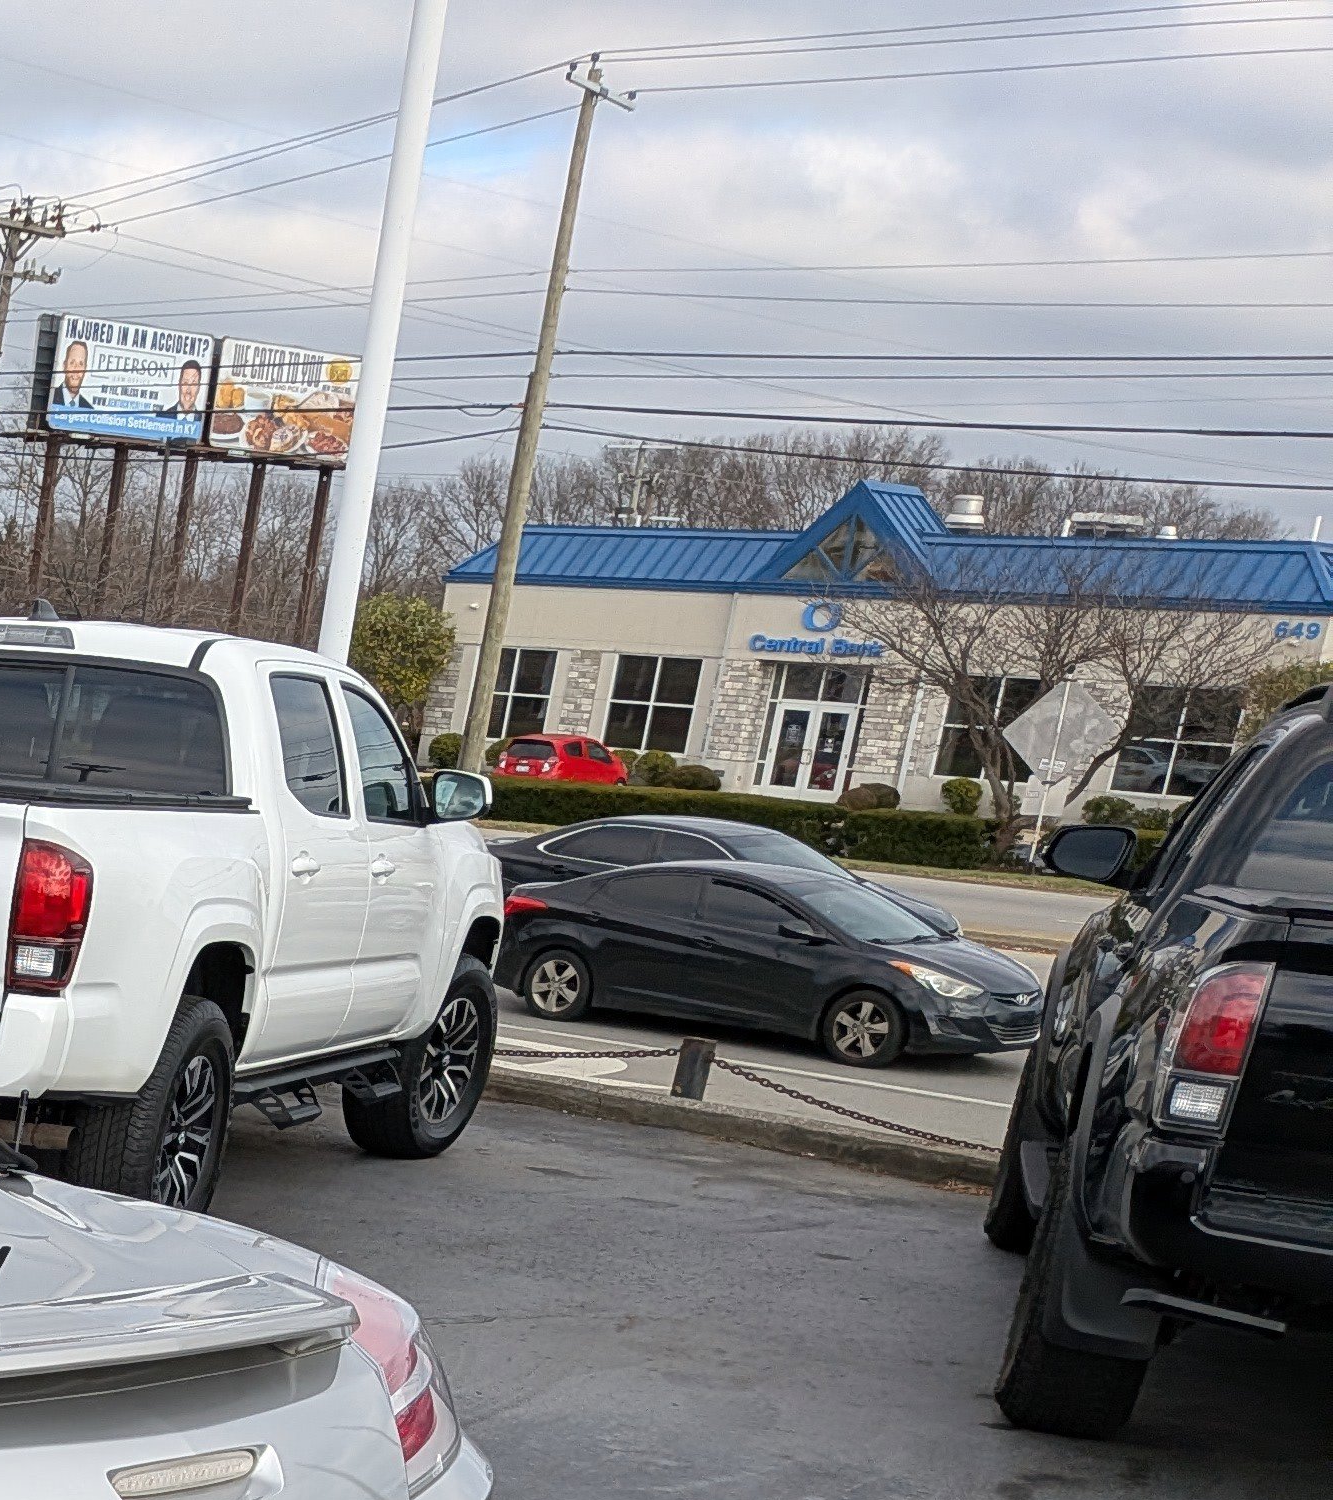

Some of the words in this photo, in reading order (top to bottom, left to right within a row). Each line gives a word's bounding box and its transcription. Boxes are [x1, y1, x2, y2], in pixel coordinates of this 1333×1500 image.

[65, 317, 114, 344] INJURED
[117, 325, 129, 347] IN
[132, 328, 148, 349] AN
[150, 331, 210, 358] ACCIDENT?
[98, 353, 171, 378] PETERSON
[232, 343, 251, 378] WE
[251, 346, 286, 382] CATER
[287, 351, 300, 385] TO
[301, 353, 324, 388] YOU
[90, 413, 126, 427] Collision
[127, 416, 174, 433] Settlement
[175, 422, 183, 434] in
[184, 423, 197, 435] KY
[1274, 620, 1321, 640] 649
[748, 634, 827, 655] Central
[831, 638, 884, 657] Bank
